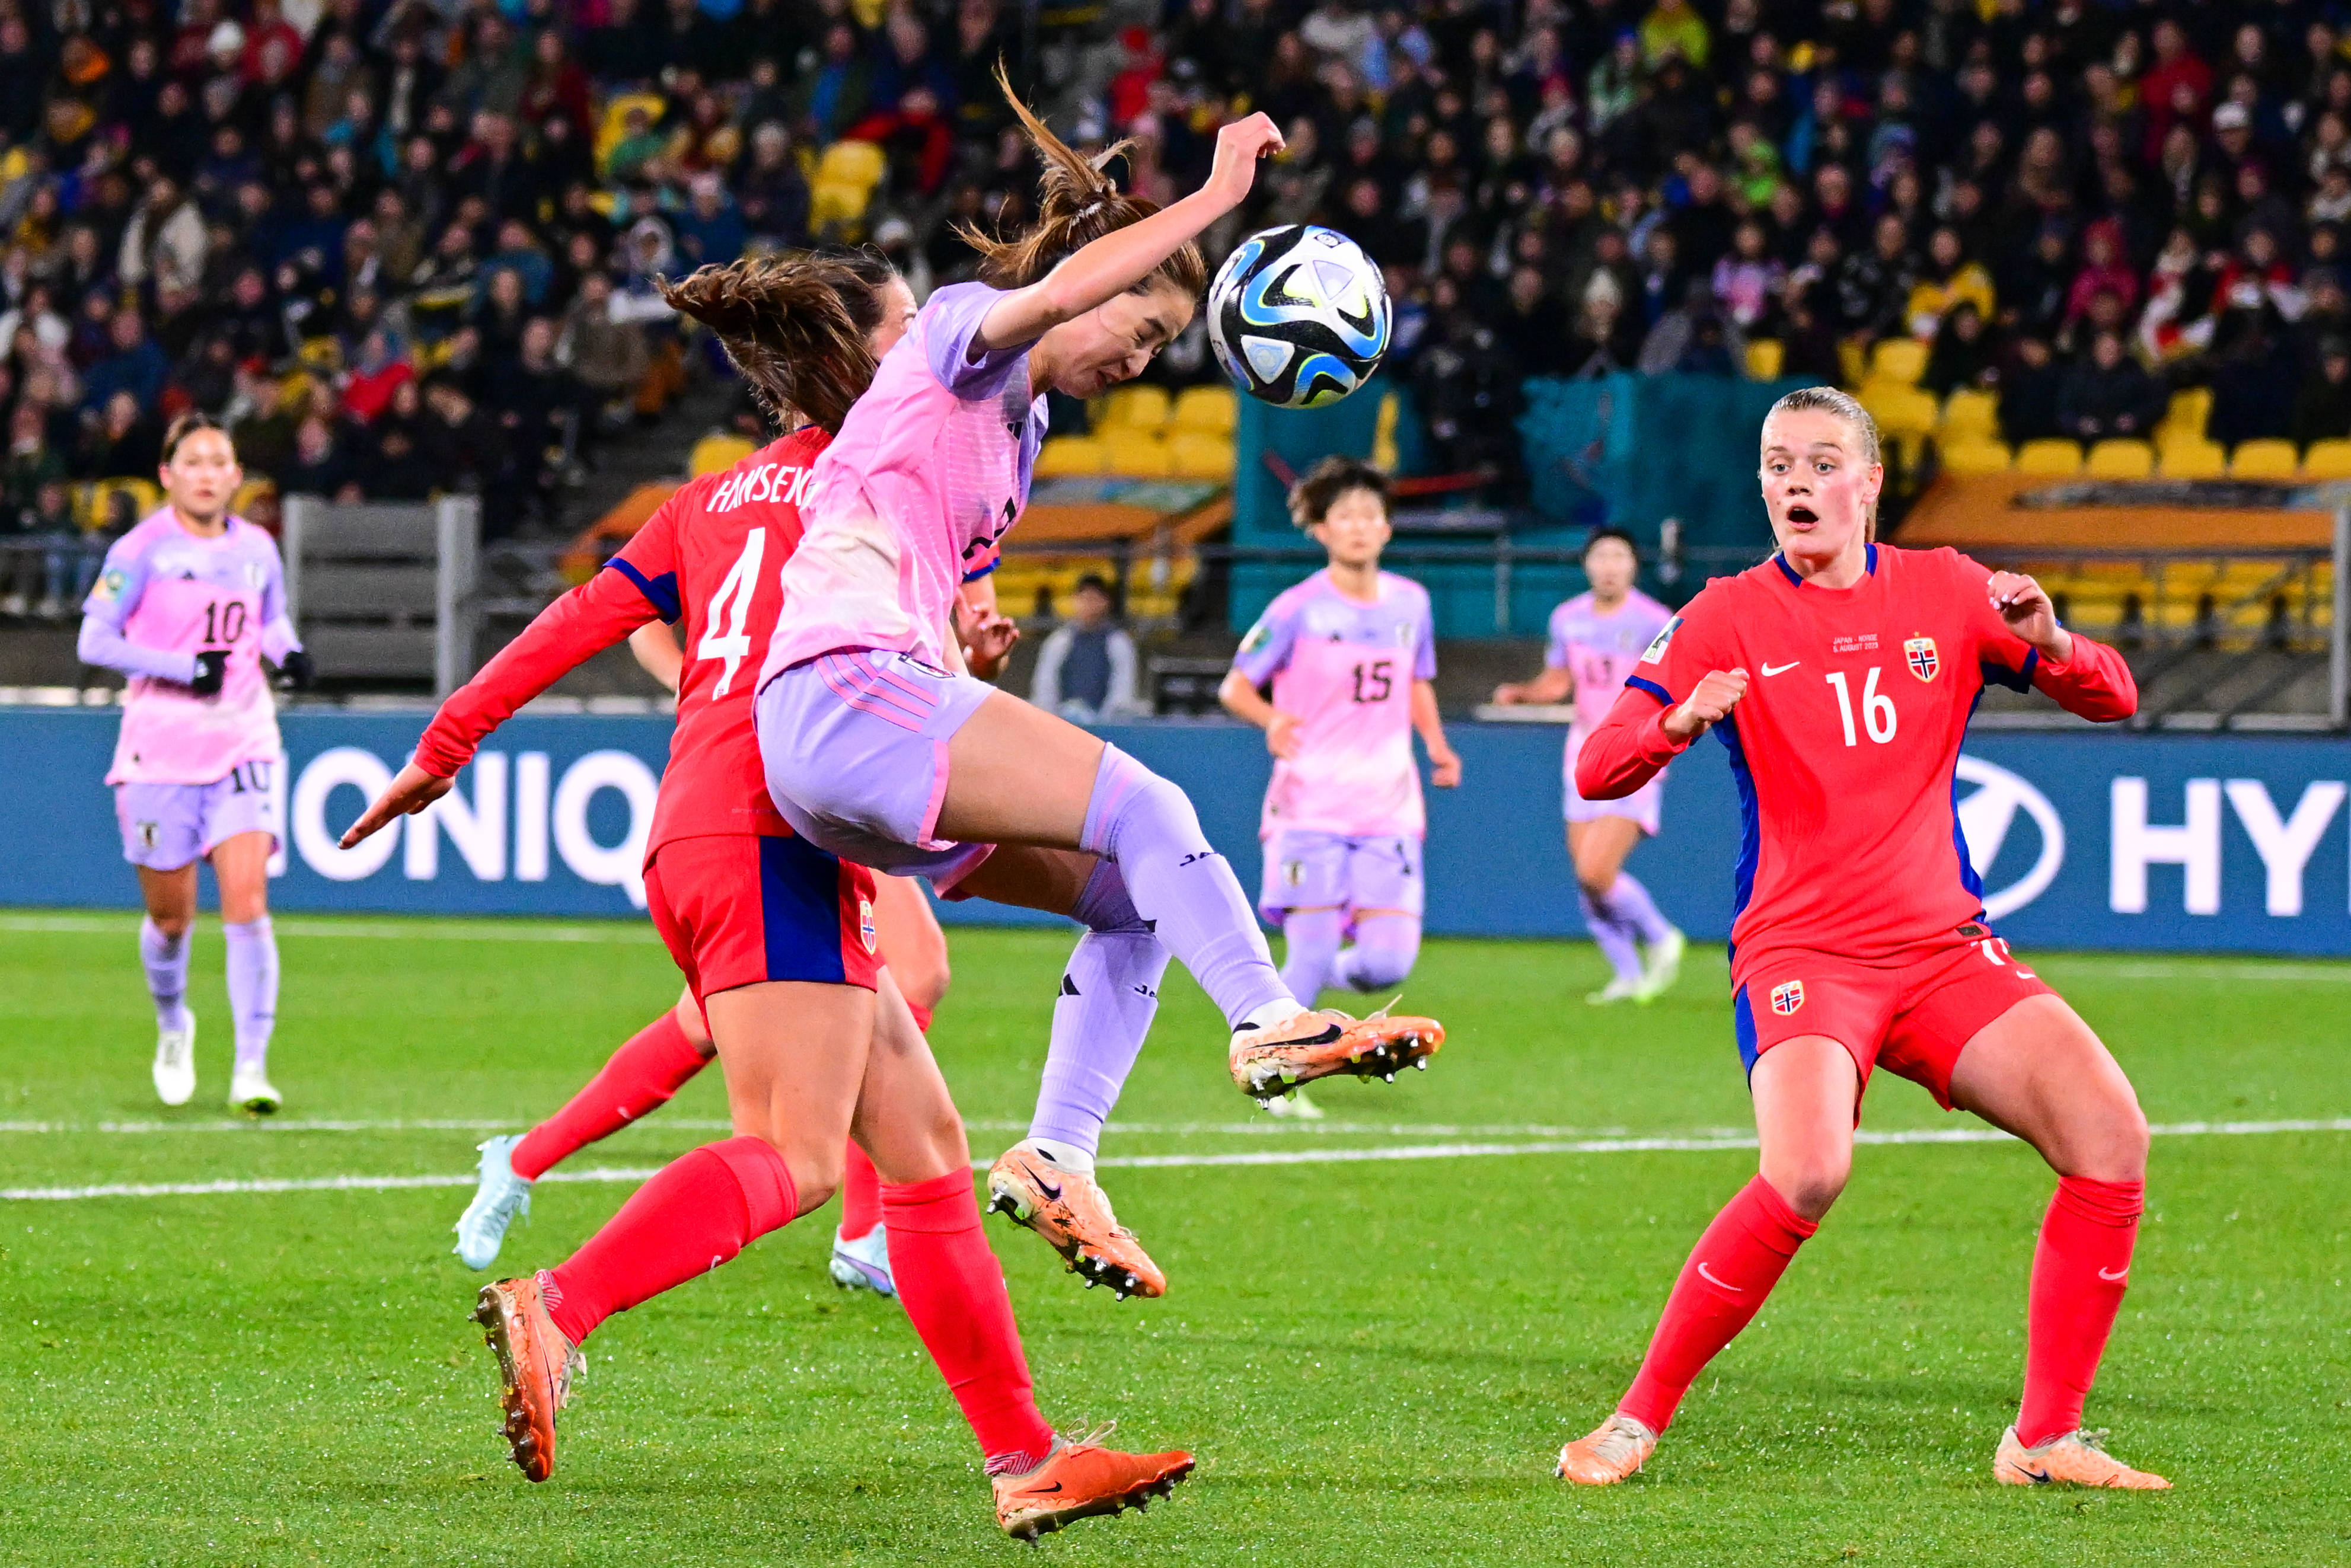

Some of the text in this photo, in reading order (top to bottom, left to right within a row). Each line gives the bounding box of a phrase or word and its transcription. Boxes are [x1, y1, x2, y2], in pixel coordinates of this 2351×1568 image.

[706, 463, 814, 512] HANSEN
[203, 601, 245, 643] 10
[697, 527, 765, 701] 4
[1840, 643, 1862, 652] AUGUST
[1353, 661, 1392, 703] 15
[1825, 667, 1897, 747] 16
[2110, 775, 2351, 917] HY
